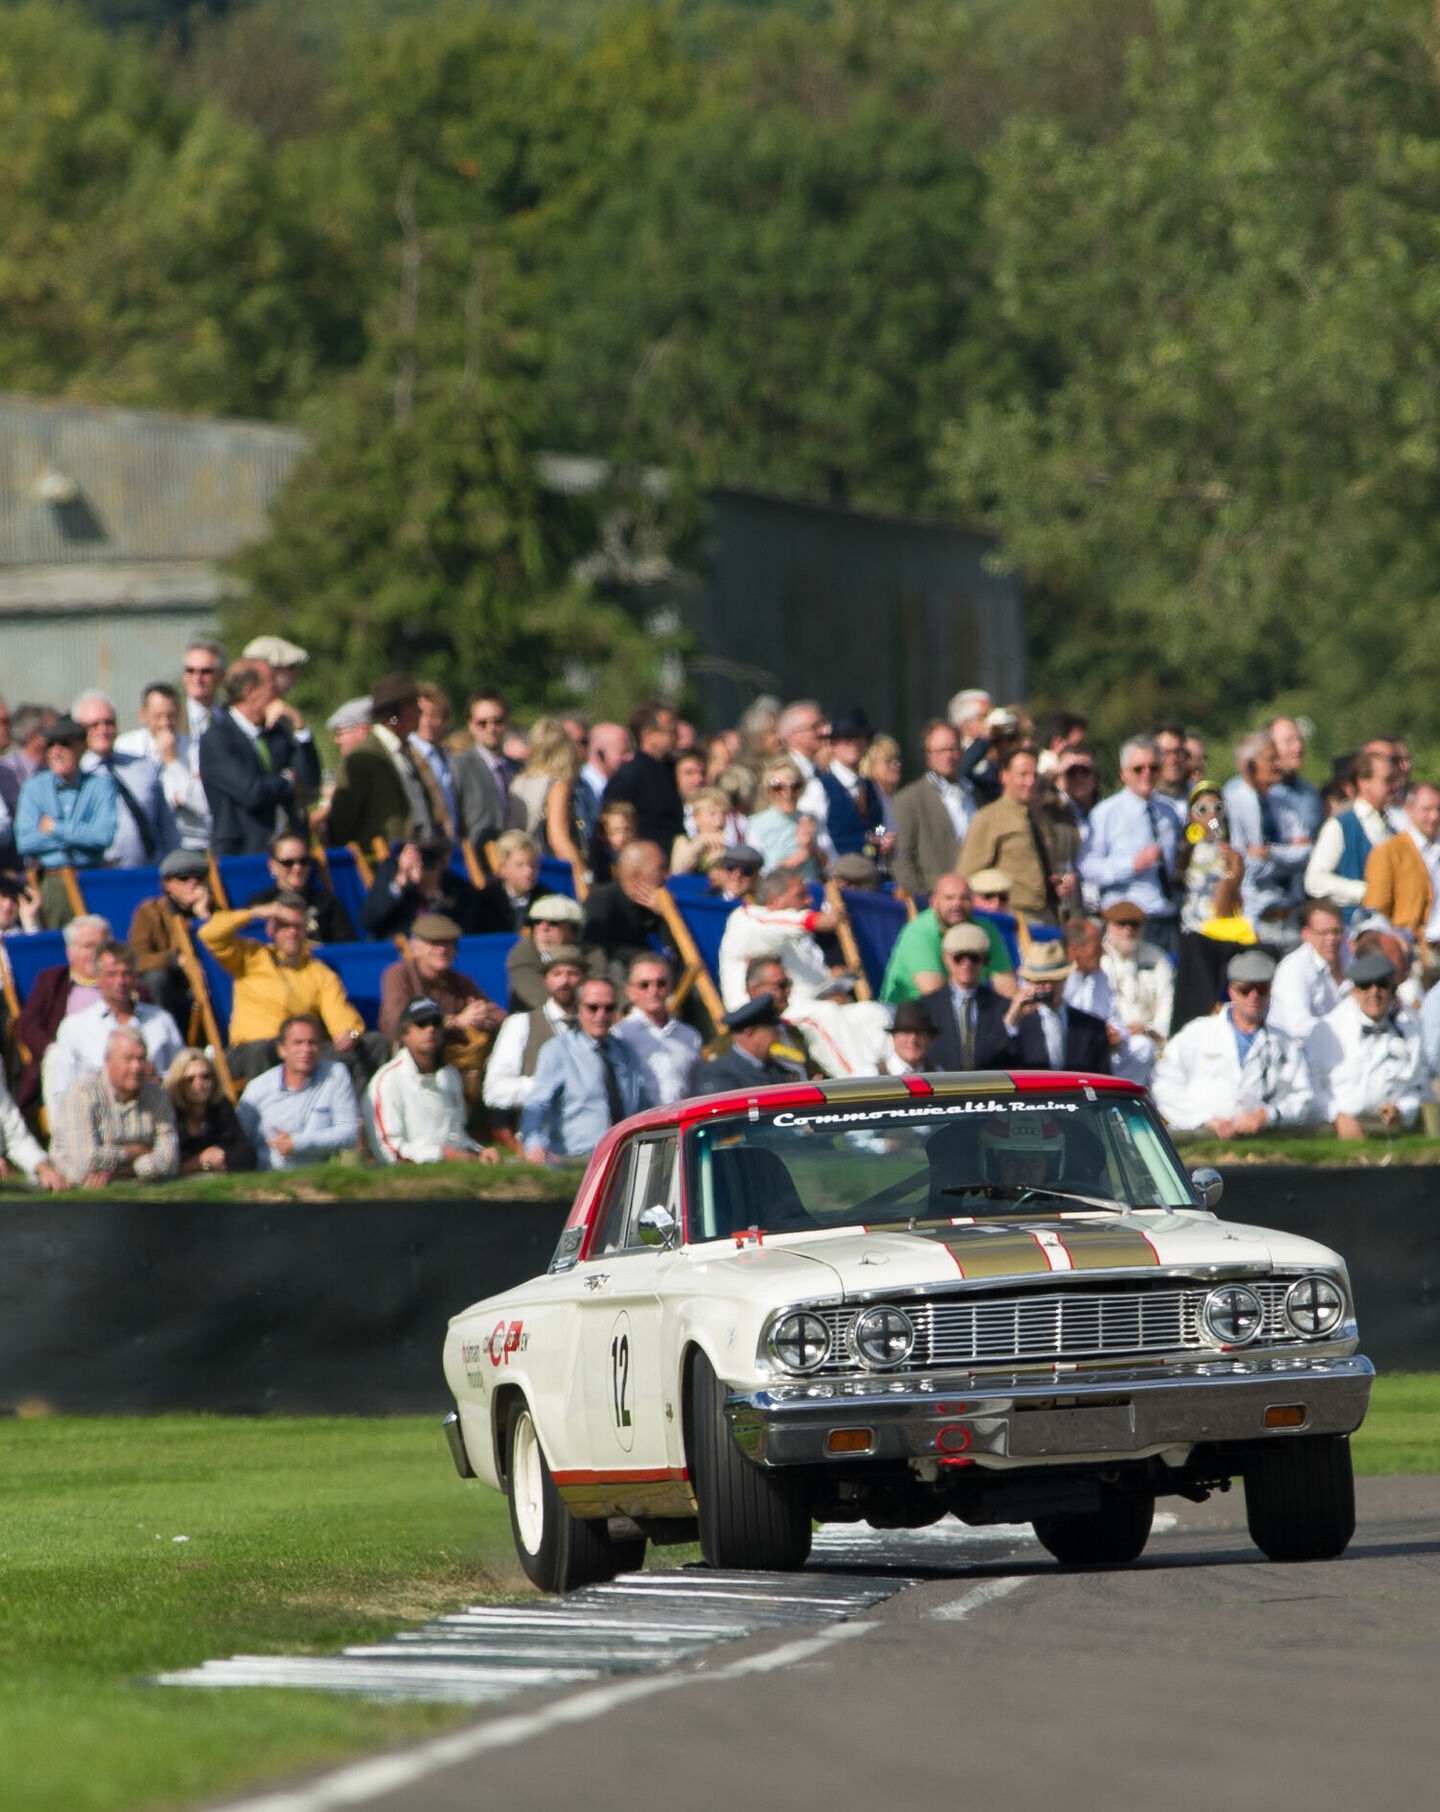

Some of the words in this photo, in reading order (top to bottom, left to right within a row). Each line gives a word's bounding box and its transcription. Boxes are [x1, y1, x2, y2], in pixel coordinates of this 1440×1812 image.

[773, 1100, 1007, 1128] Commonwealth
[1009, 1101, 1079, 1113] Racing
[612, 1335, 632, 1428] 12
